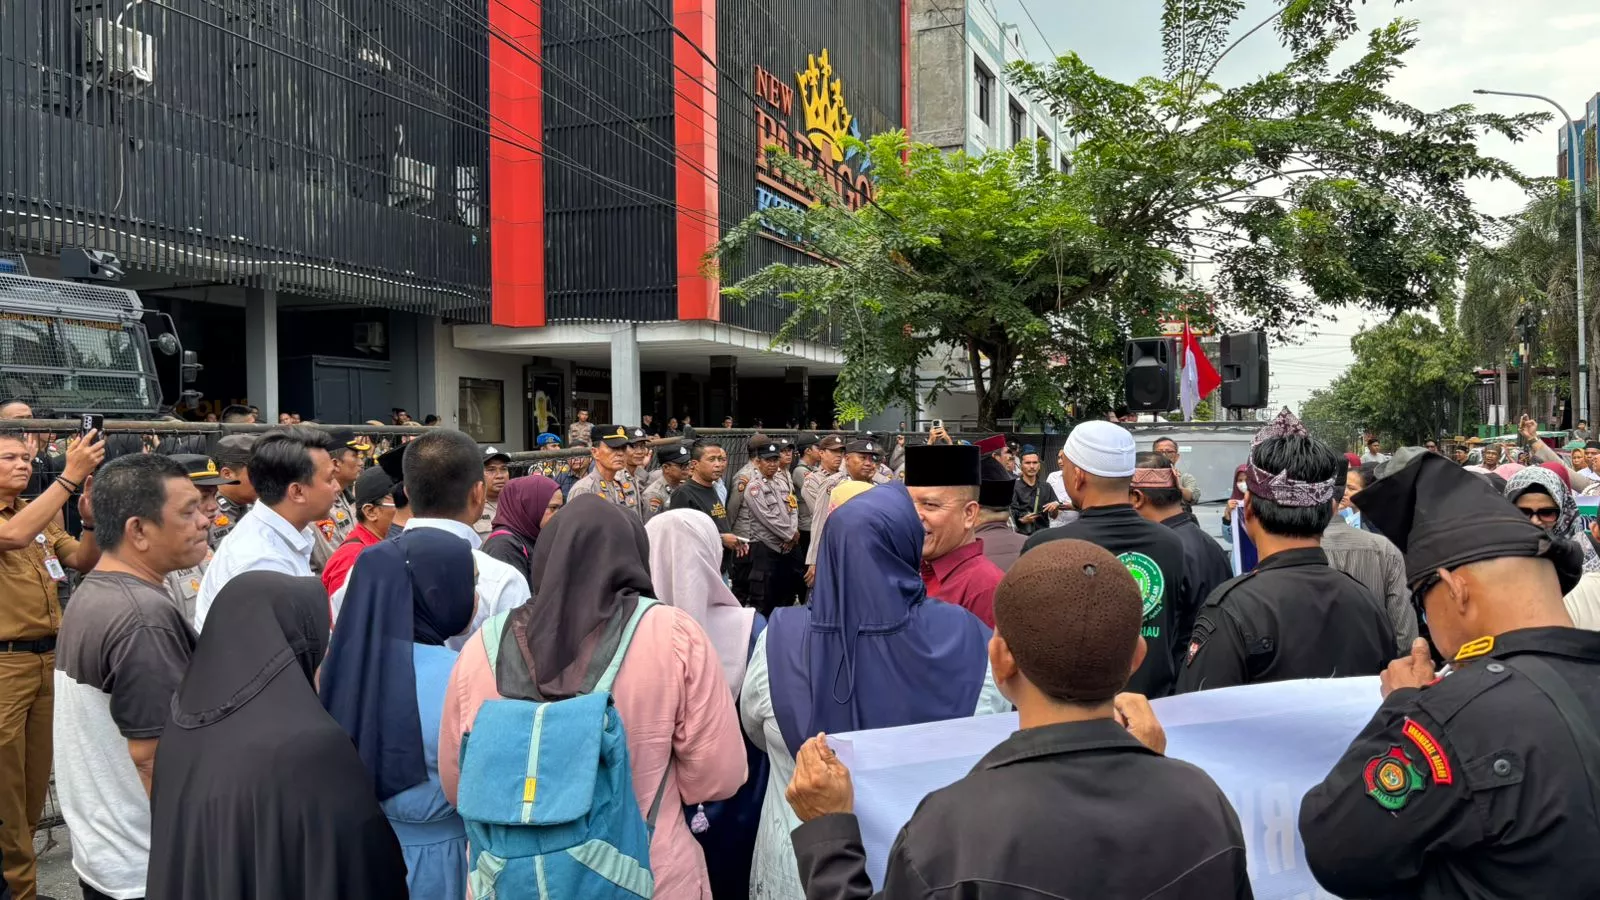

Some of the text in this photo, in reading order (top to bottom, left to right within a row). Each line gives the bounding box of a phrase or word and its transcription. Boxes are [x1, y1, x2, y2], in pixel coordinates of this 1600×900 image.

[755, 64, 793, 116] NEW
[755, 105, 876, 212] PARAGO
[576, 368, 601, 377] ARAGON
